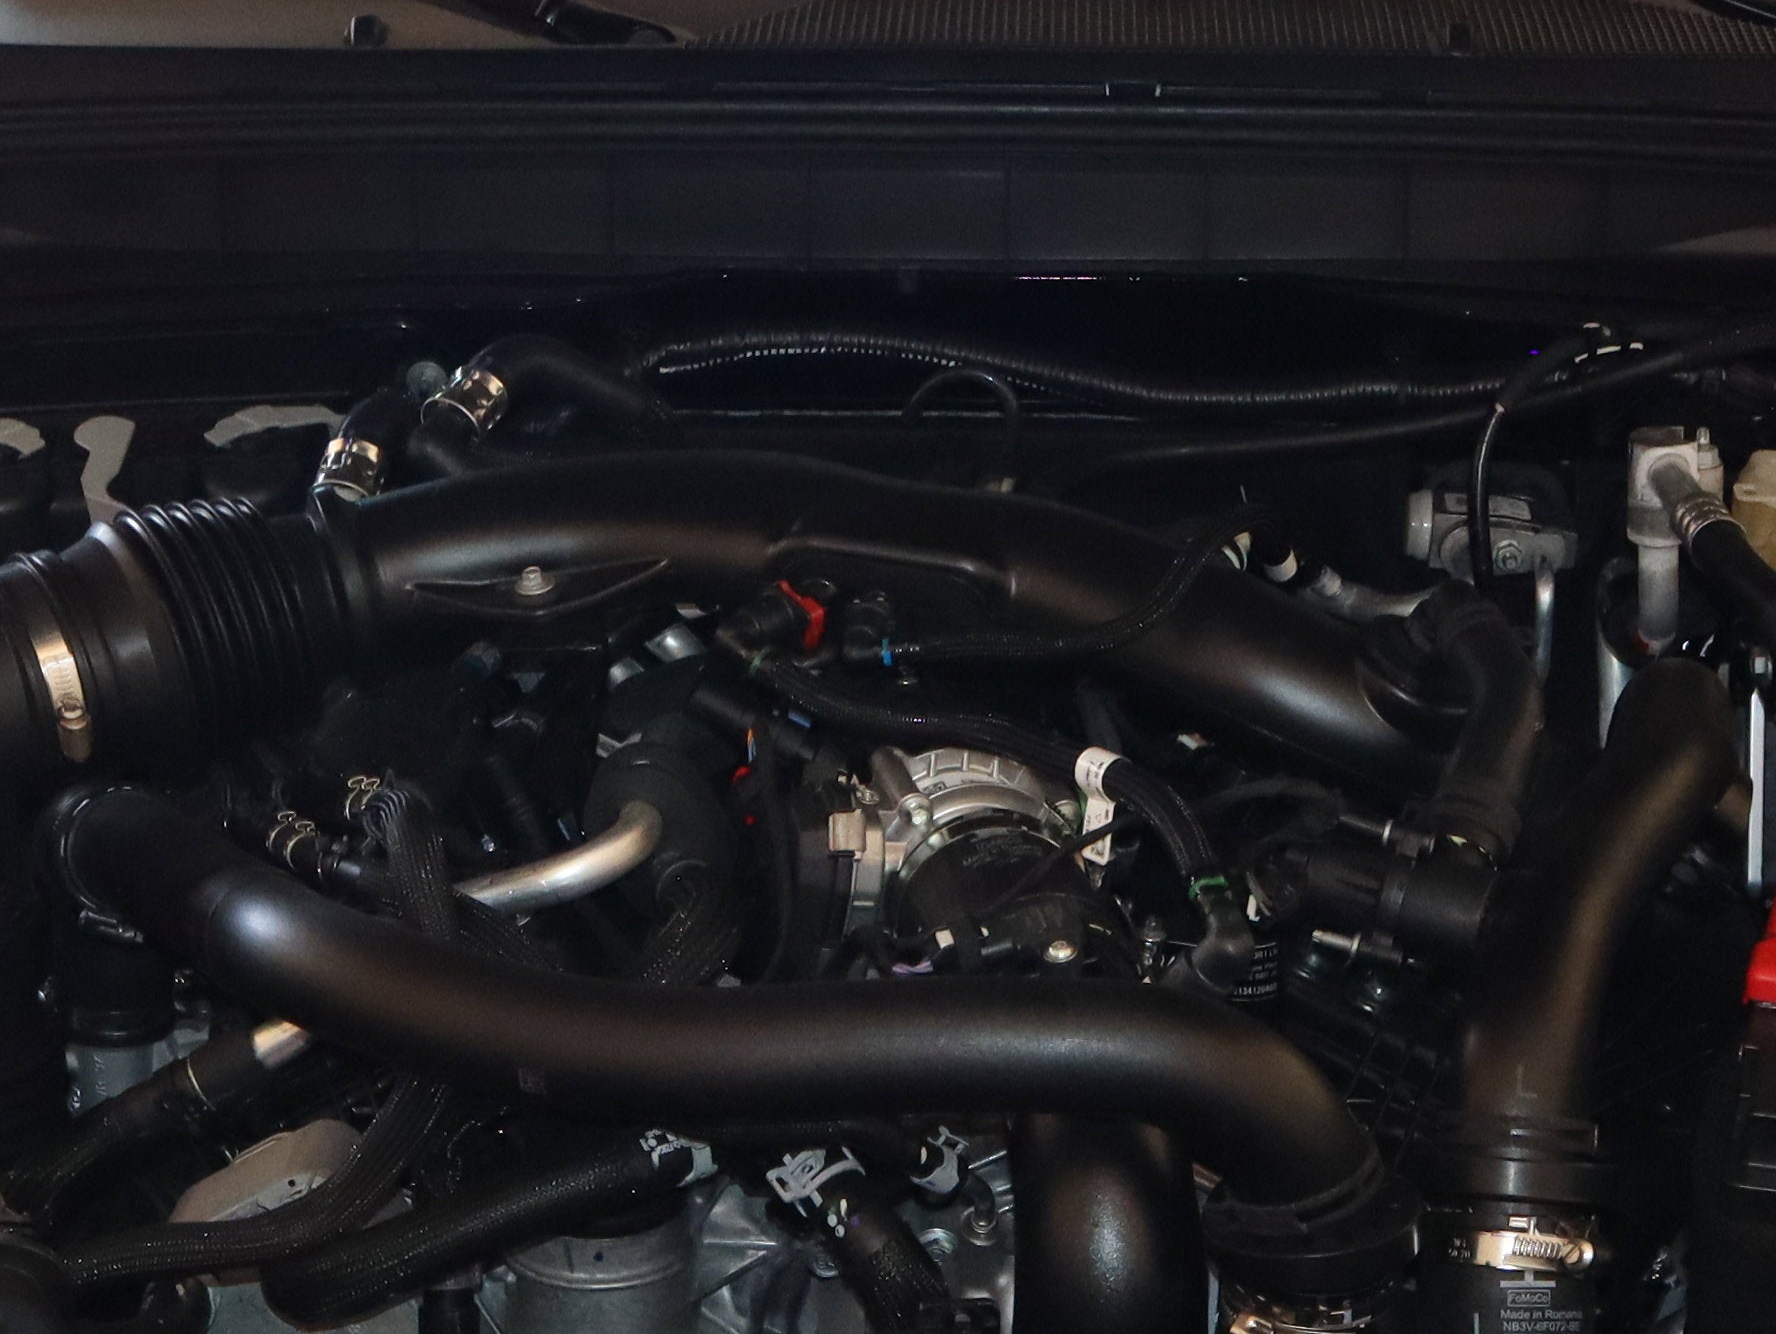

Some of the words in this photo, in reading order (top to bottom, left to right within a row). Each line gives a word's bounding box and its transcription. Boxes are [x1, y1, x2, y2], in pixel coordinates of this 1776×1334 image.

[1509, 1292, 1550, 1303] FoMoCo
[1500, 1309, 1531, 1319] Made
[1532, 1309, 1543, 1319] in
